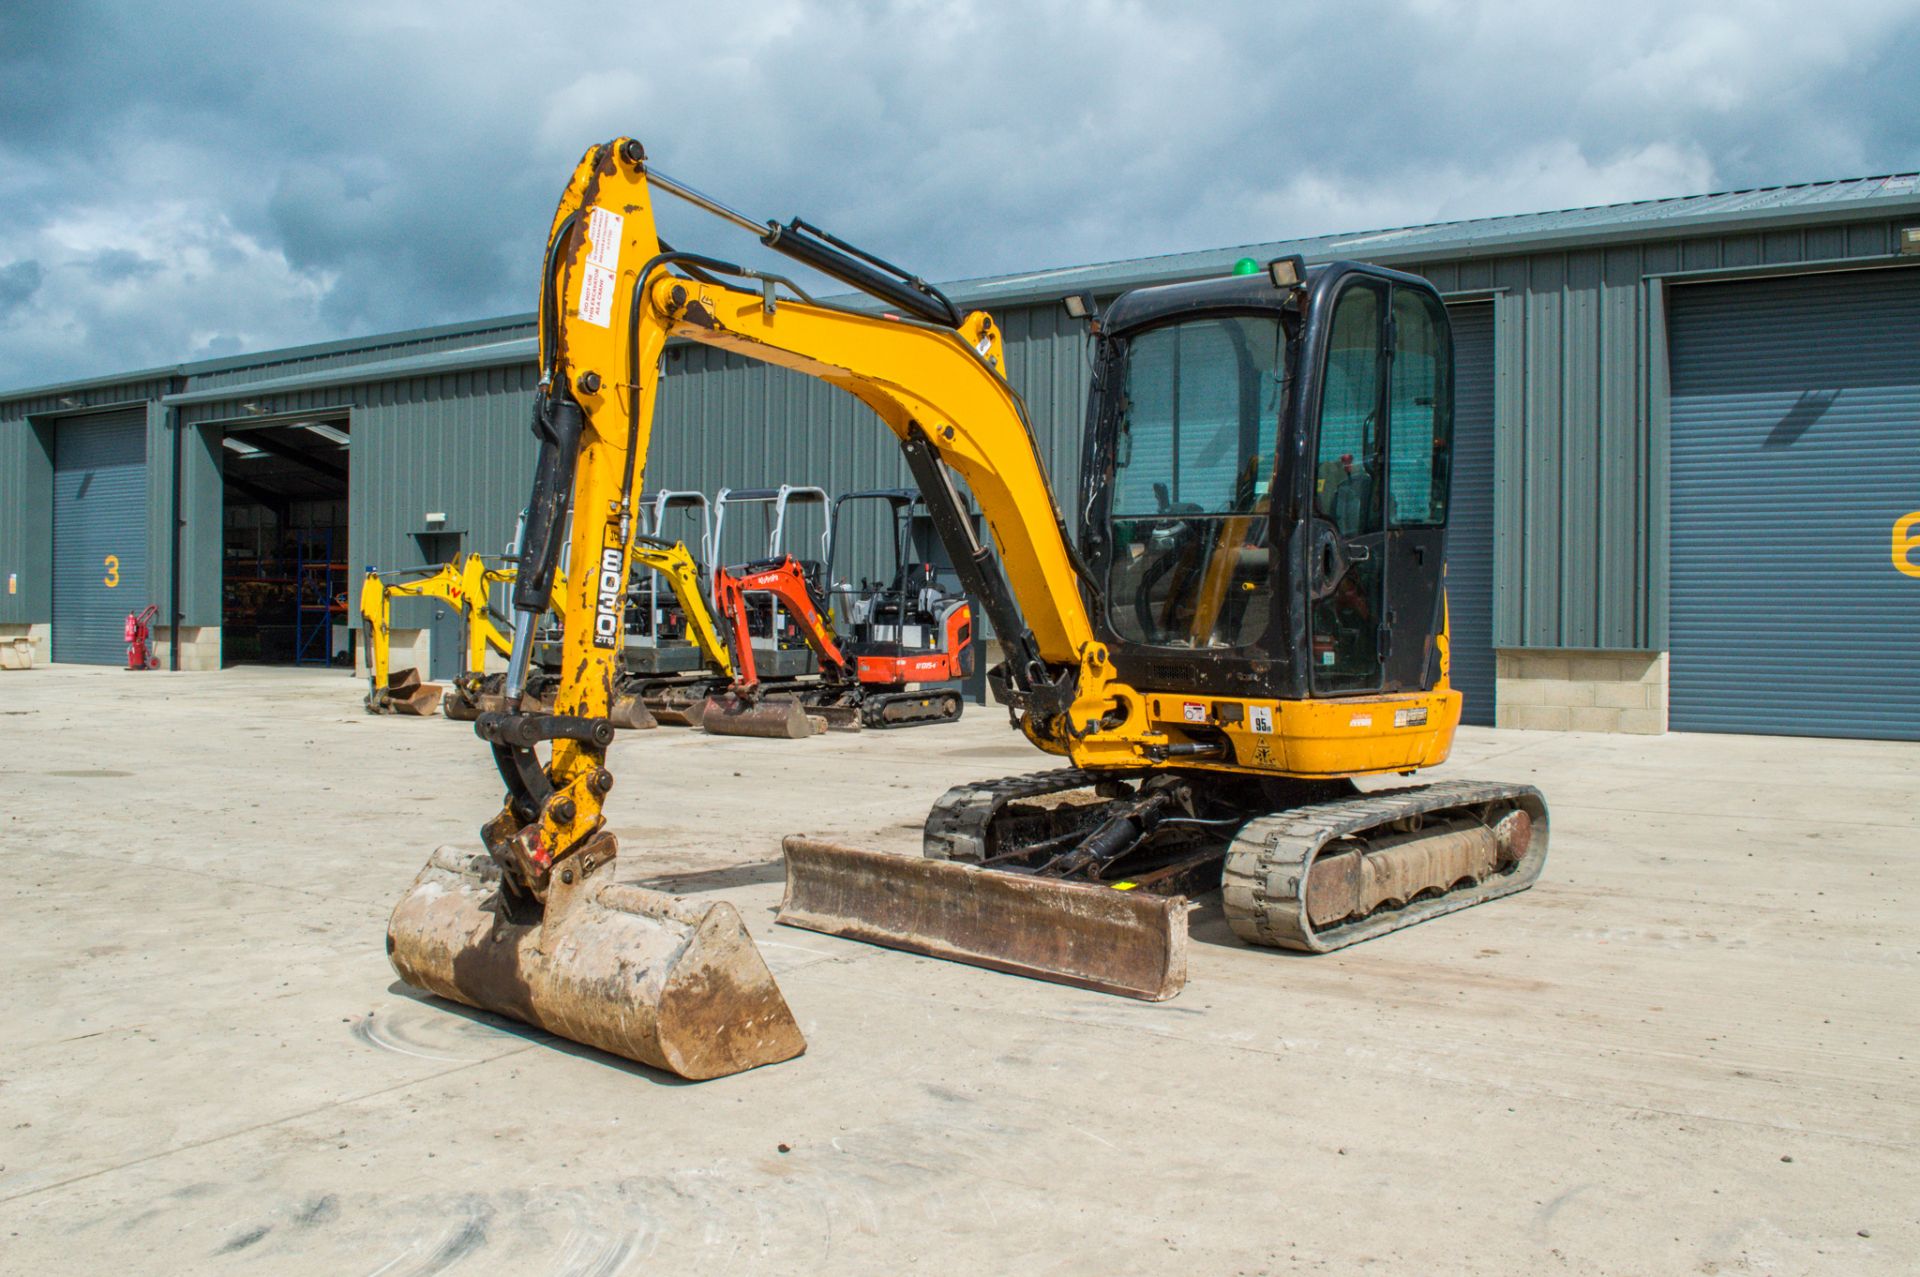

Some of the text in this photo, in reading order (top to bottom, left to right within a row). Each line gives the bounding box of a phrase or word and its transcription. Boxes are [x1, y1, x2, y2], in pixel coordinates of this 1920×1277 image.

[104, 554, 120, 588] 3
[597, 547, 623, 636] 8030
[1255, 717, 1267, 731] 95
